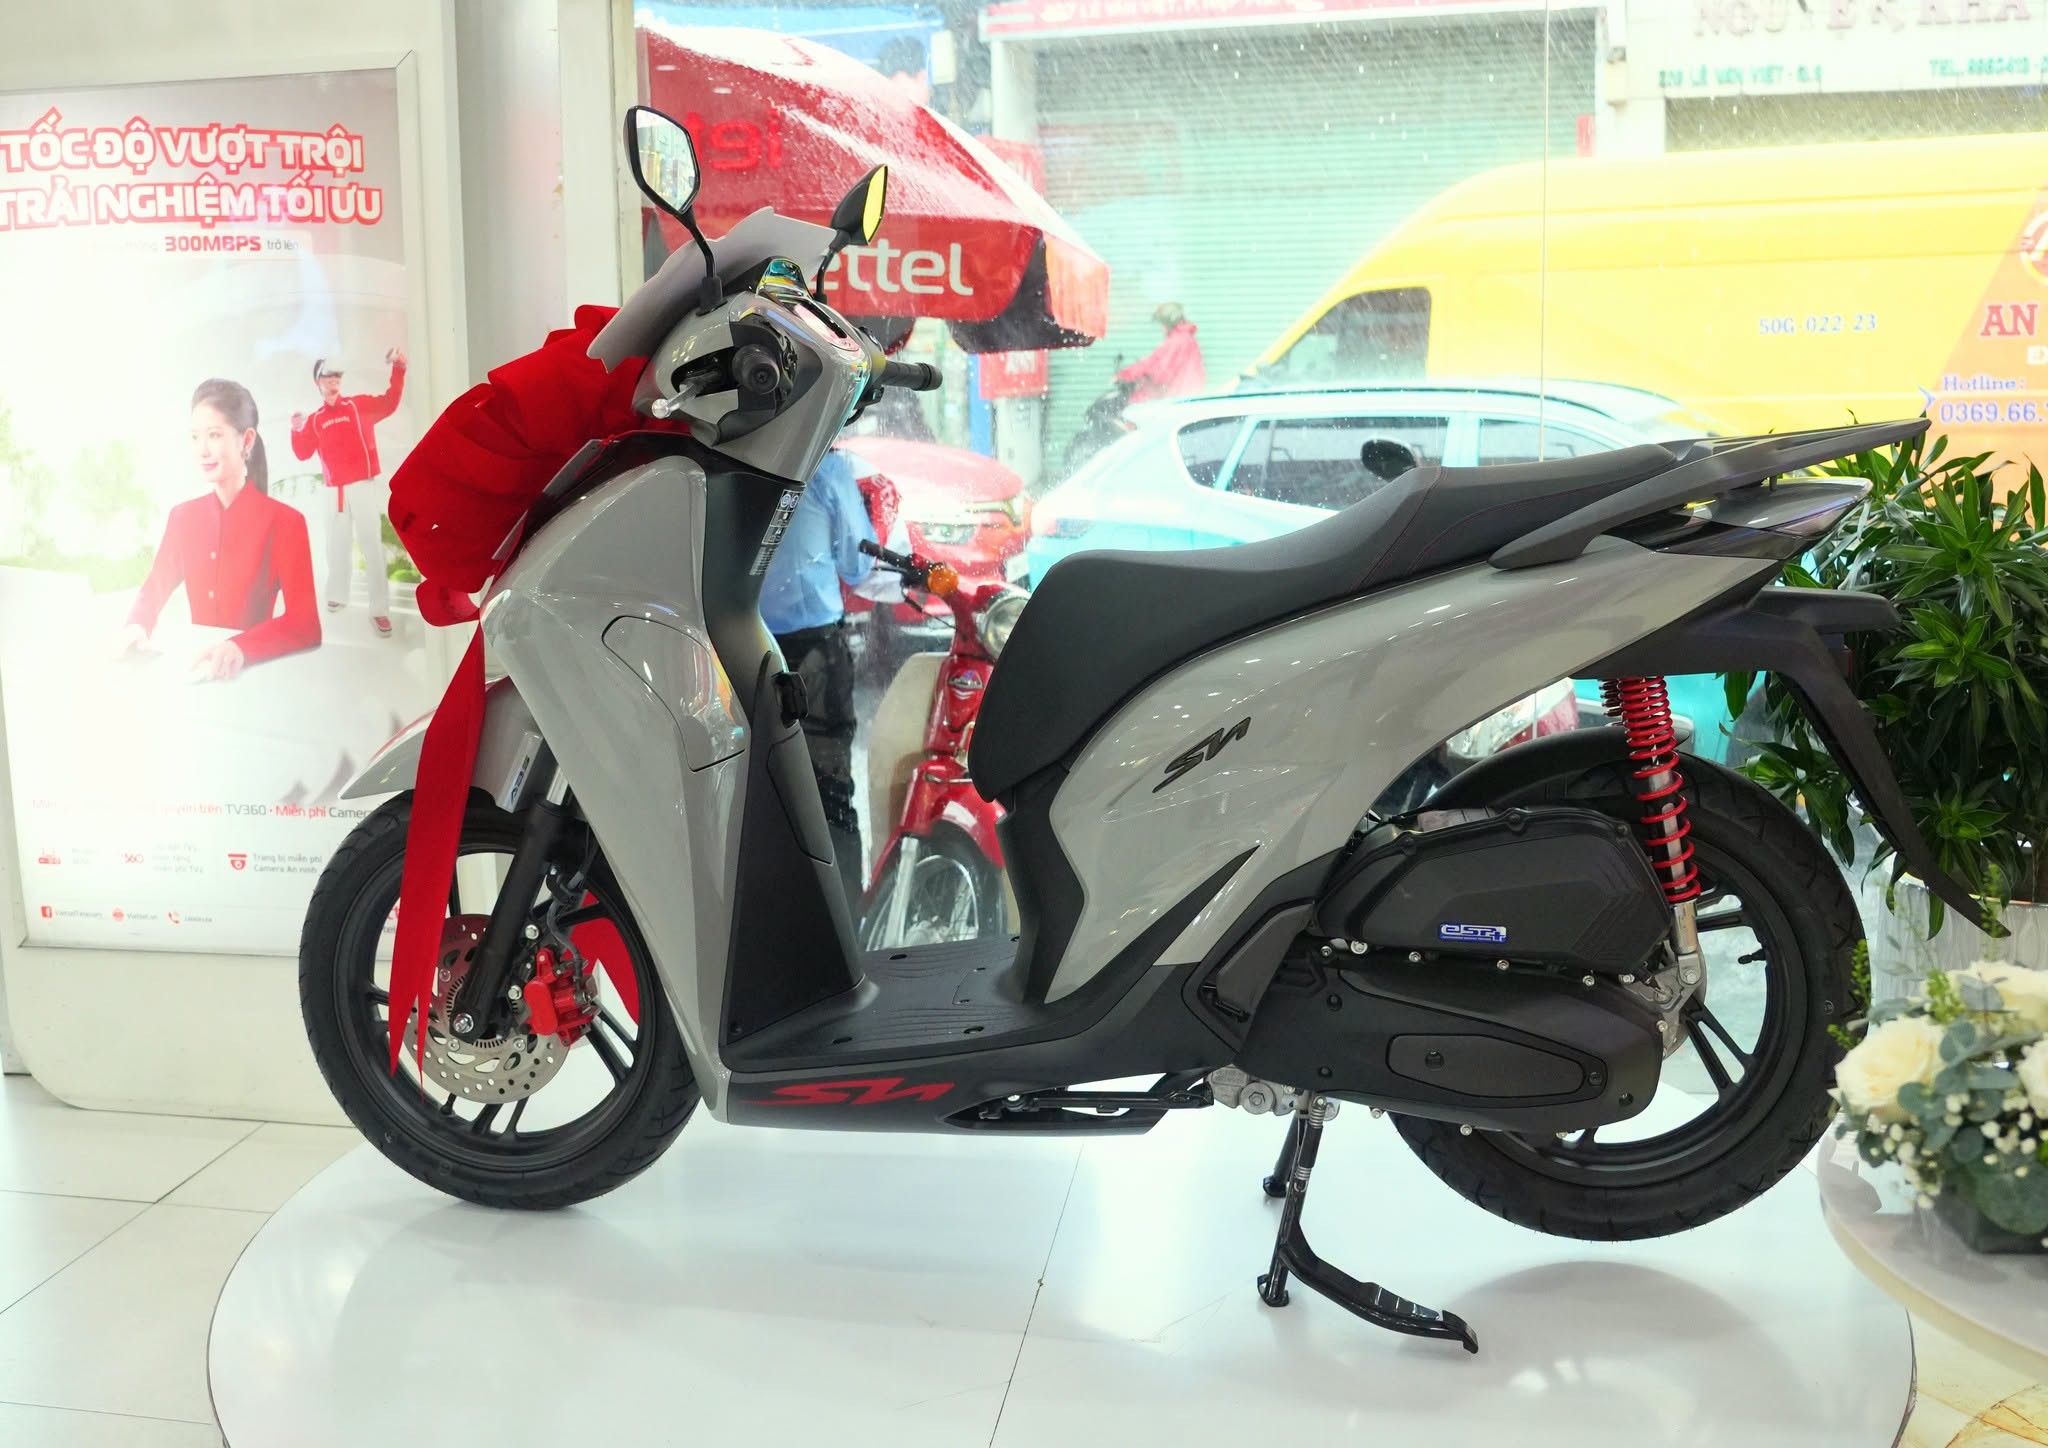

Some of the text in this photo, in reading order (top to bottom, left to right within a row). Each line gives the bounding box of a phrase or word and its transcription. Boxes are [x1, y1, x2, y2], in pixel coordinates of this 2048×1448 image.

[3, 107, 364, 178] TỐC ĐỘ VƯỢT TRỘI
[96, 172, 256, 228] NGHIỆM
[260, 170, 326, 224] TỐI
[330, 182, 383, 226] ƯU
[164, 235, 262, 252] 300MBPS
[1980, 303, 2038, 336] AN
[1943, 375, 2025, 390] Hotline:
[1940, 402, 2048, 422] 0369.66.
[226, 803, 267, 816] TV360
[276, 802, 306, 817] Miễn
[308, 805, 327, 819] phí
